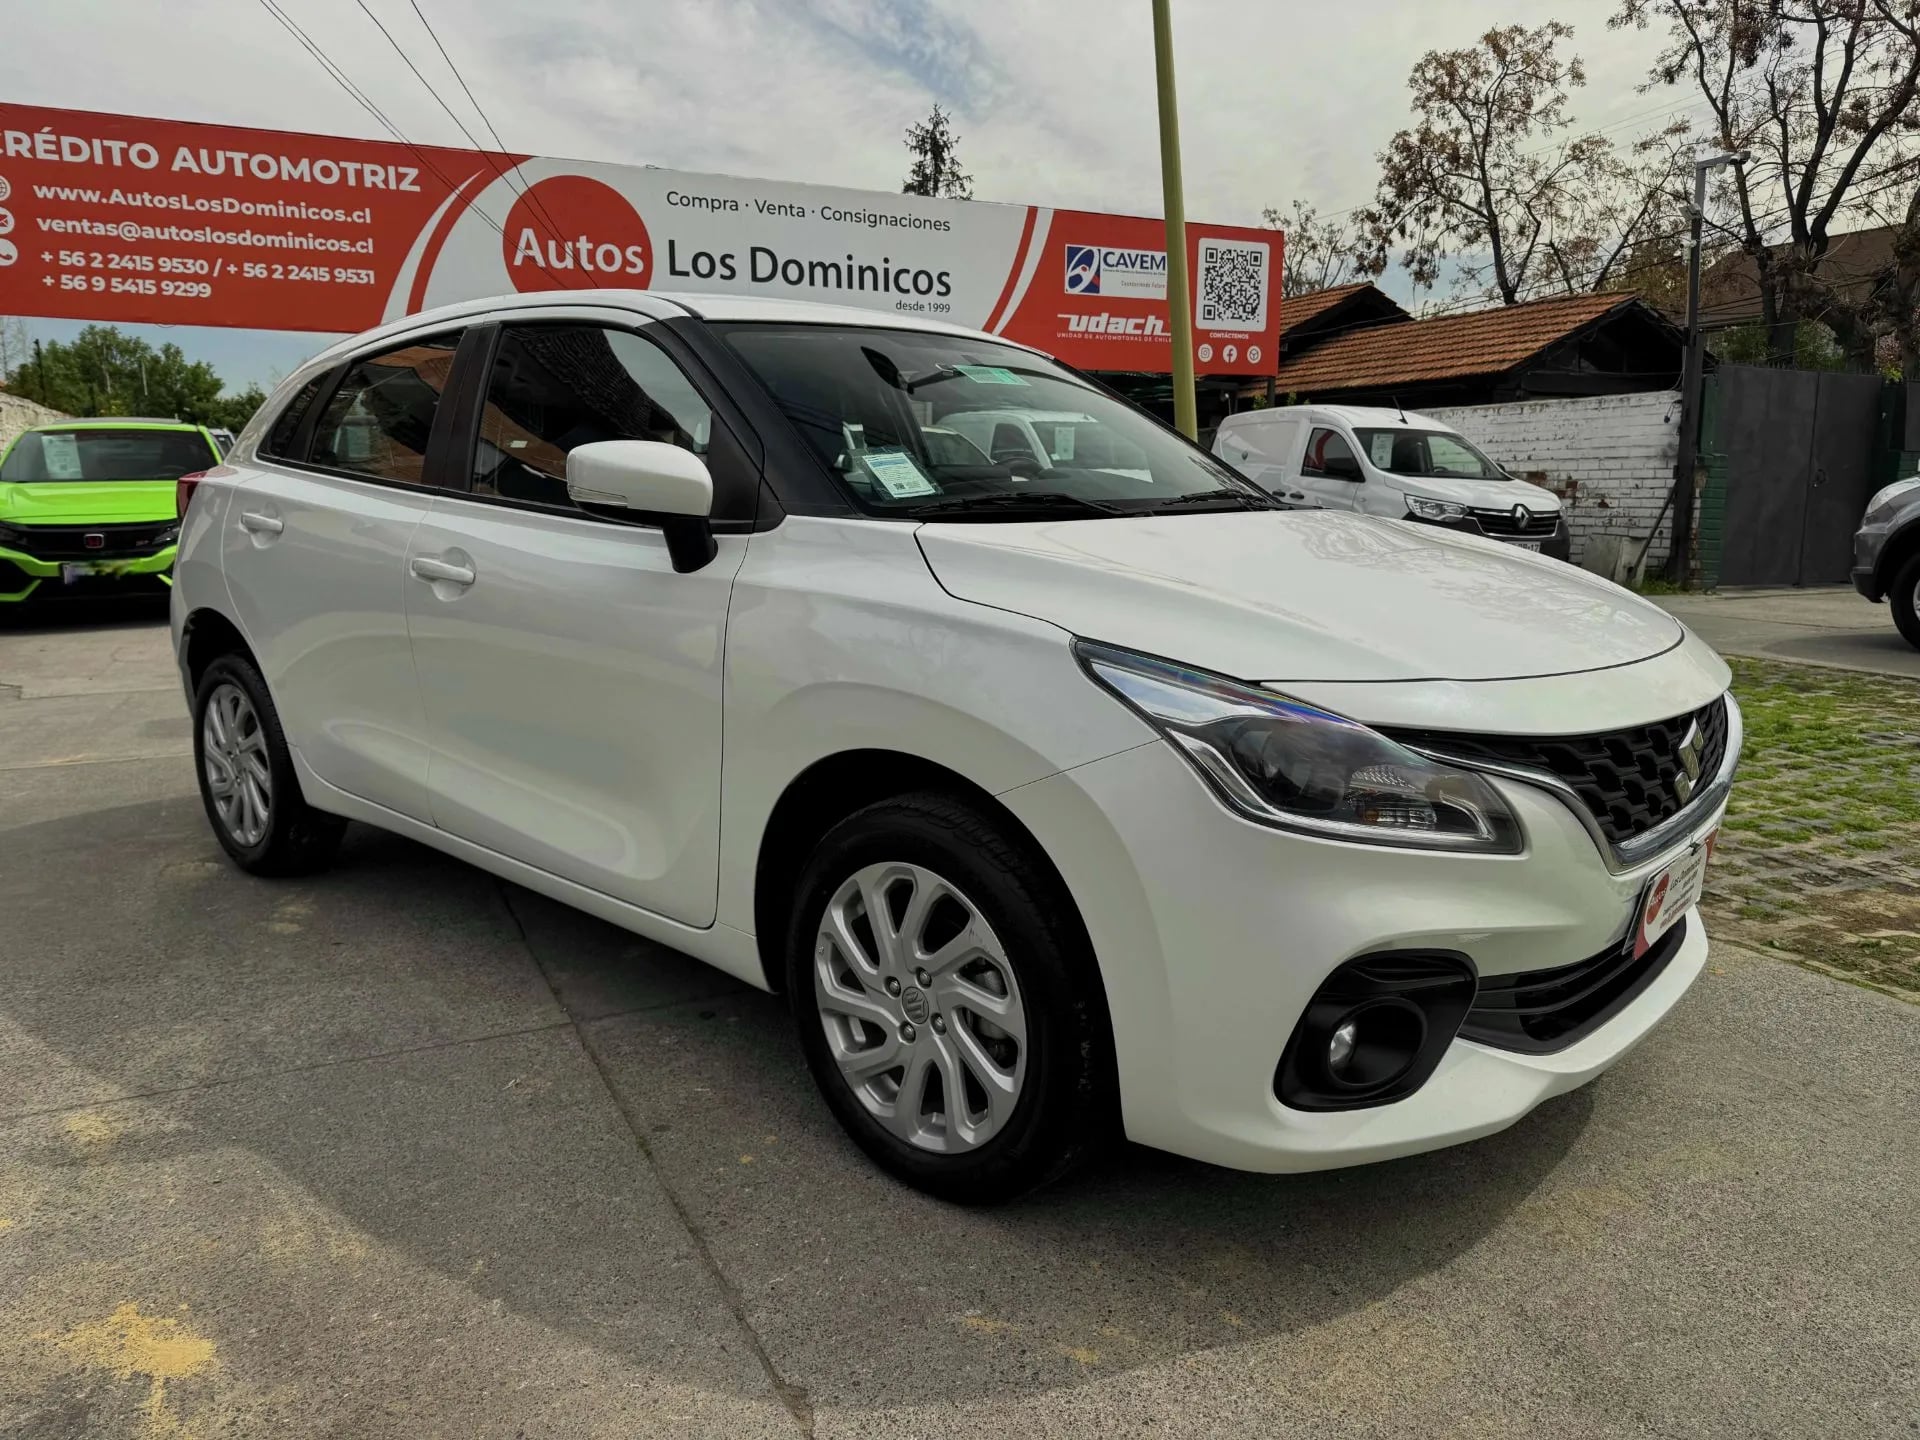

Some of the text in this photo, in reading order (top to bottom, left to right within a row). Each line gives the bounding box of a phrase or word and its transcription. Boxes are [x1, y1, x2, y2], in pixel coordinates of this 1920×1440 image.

[171, 146, 421, 192] AUTOMOTRIZ
[33, 184, 371, 224] www.AutosLosDominicos.cl
[667, 190, 951, 232] Compra Venta Consignaciones
[36, 214, 374, 254] ventas@autoslosdominicos.cl
[512, 228, 645, 274] Autos
[58, 250, 86, 267] 56
[89, 252, 104, 268] 2
[107, 253, 155, 271] 2415
[157, 257, 209, 275] 9530
[243, 262, 268, 279] 56
[271, 264, 284, 279] 2
[287, 265, 331, 282] 2415
[333, 267, 375, 285] 9531
[668, 239, 952, 297] Los Dominicos
[1102, 251, 1166, 271] CAVEM
[60, 274, 88, 291] 56
[91, 276, 106, 292] 9
[110, 277, 157, 295] 5415
[160, 280, 212, 298] 9299
[895, 299, 951, 313] desde 1999
[1057, 312, 1172, 337] udach
